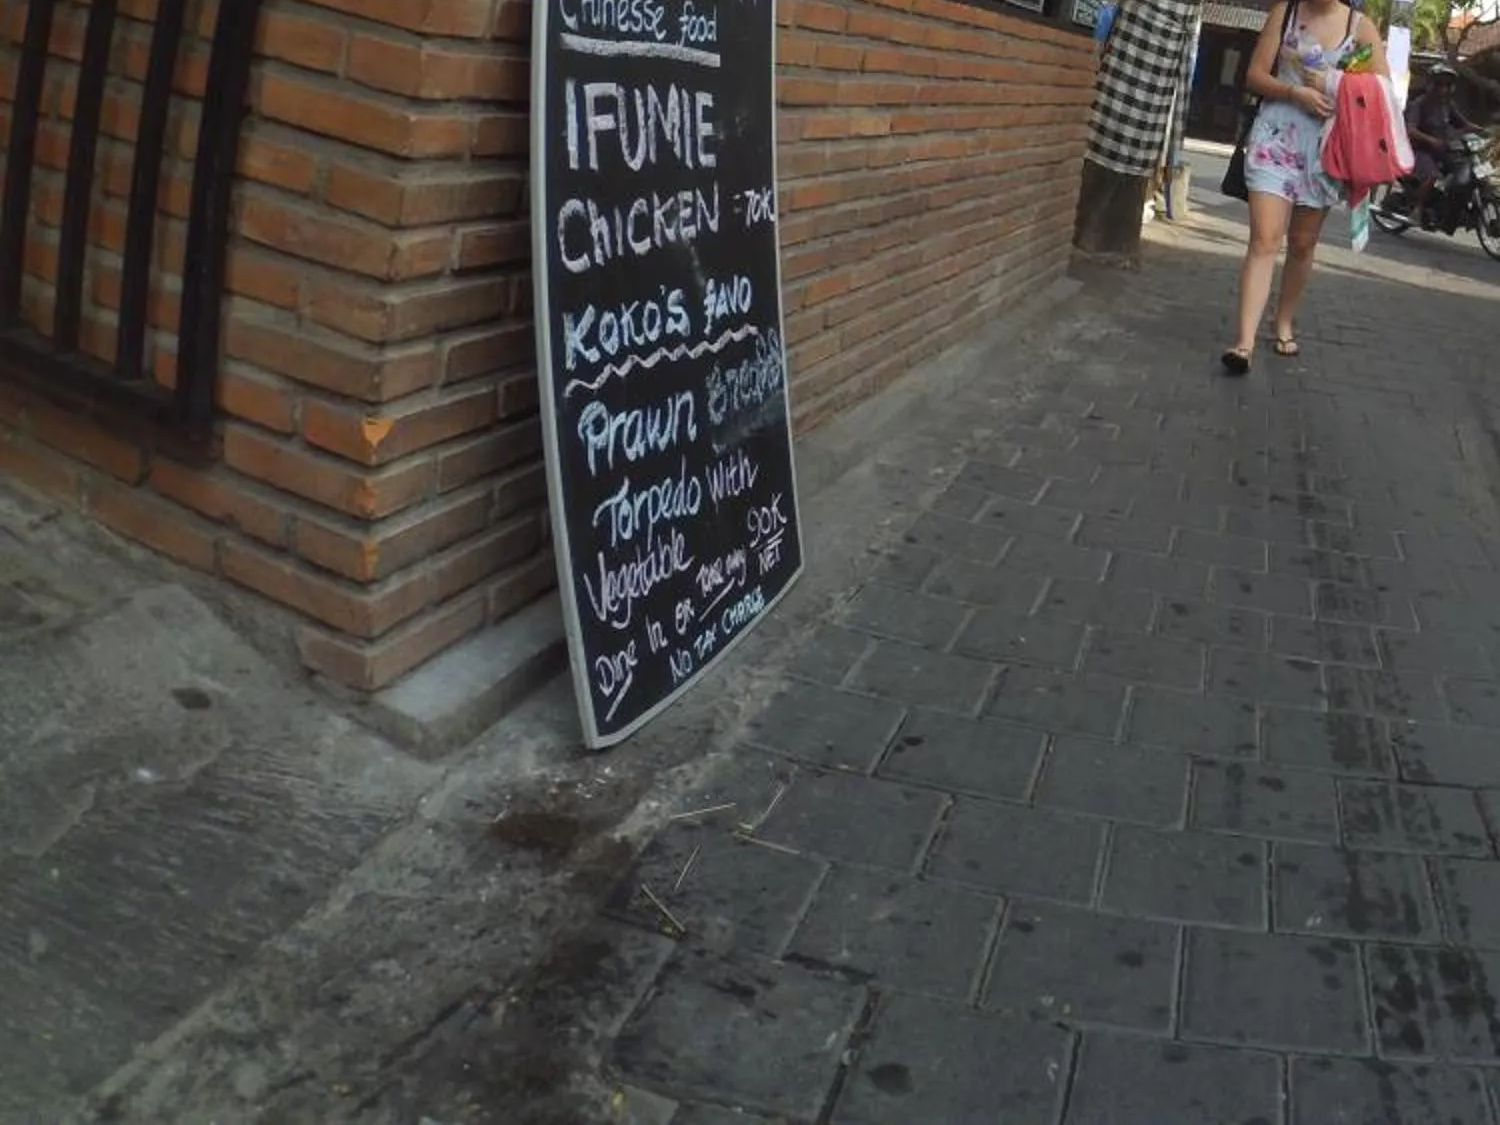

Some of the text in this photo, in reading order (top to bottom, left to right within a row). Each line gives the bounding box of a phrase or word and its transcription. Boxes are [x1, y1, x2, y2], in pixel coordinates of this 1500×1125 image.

[678, 0, 718, 47] food
[593, 454, 702, 550] Torpedo
[584, 528, 696, 630] Vegetable
[757, 538, 783, 576] NET
